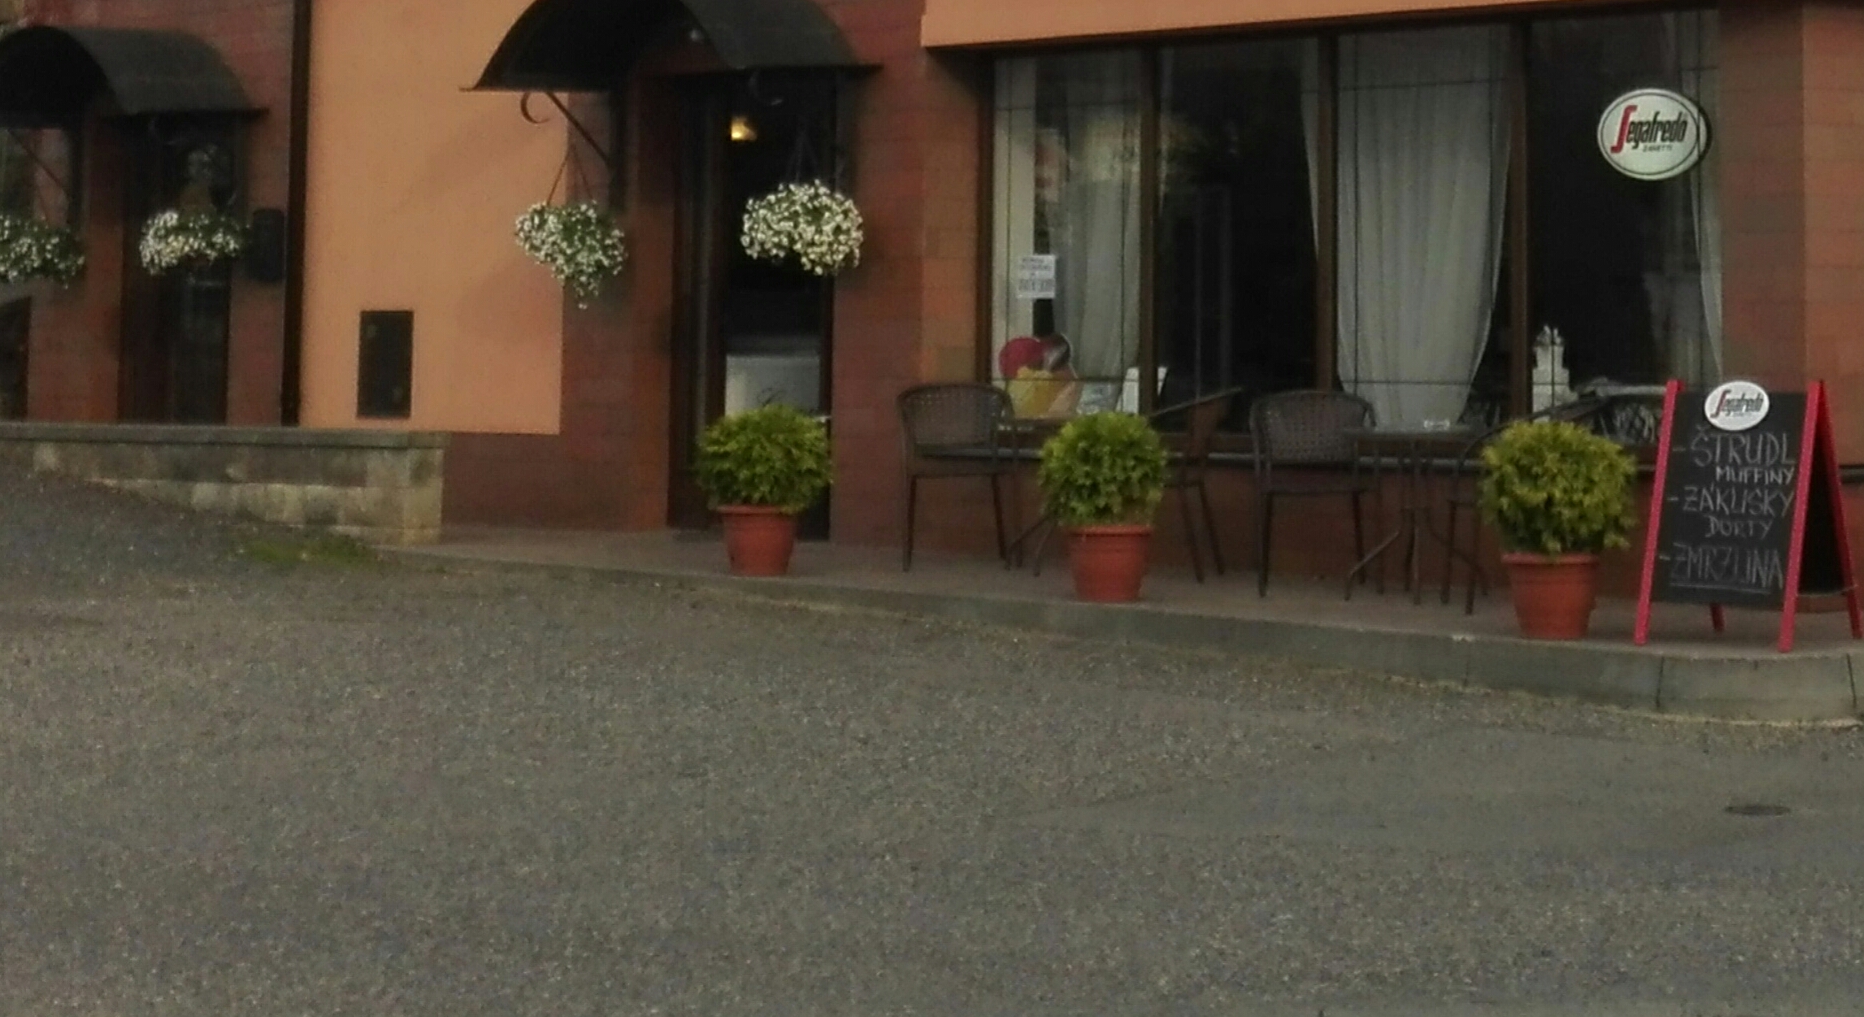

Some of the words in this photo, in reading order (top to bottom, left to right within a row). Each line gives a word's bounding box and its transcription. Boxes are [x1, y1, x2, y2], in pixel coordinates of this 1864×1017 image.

[1610, 105, 1688, 153] Segafredo
[1690, 425, 1795, 467] ŠTRUDL
[1715, 465, 1795, 485] MUFFINY
